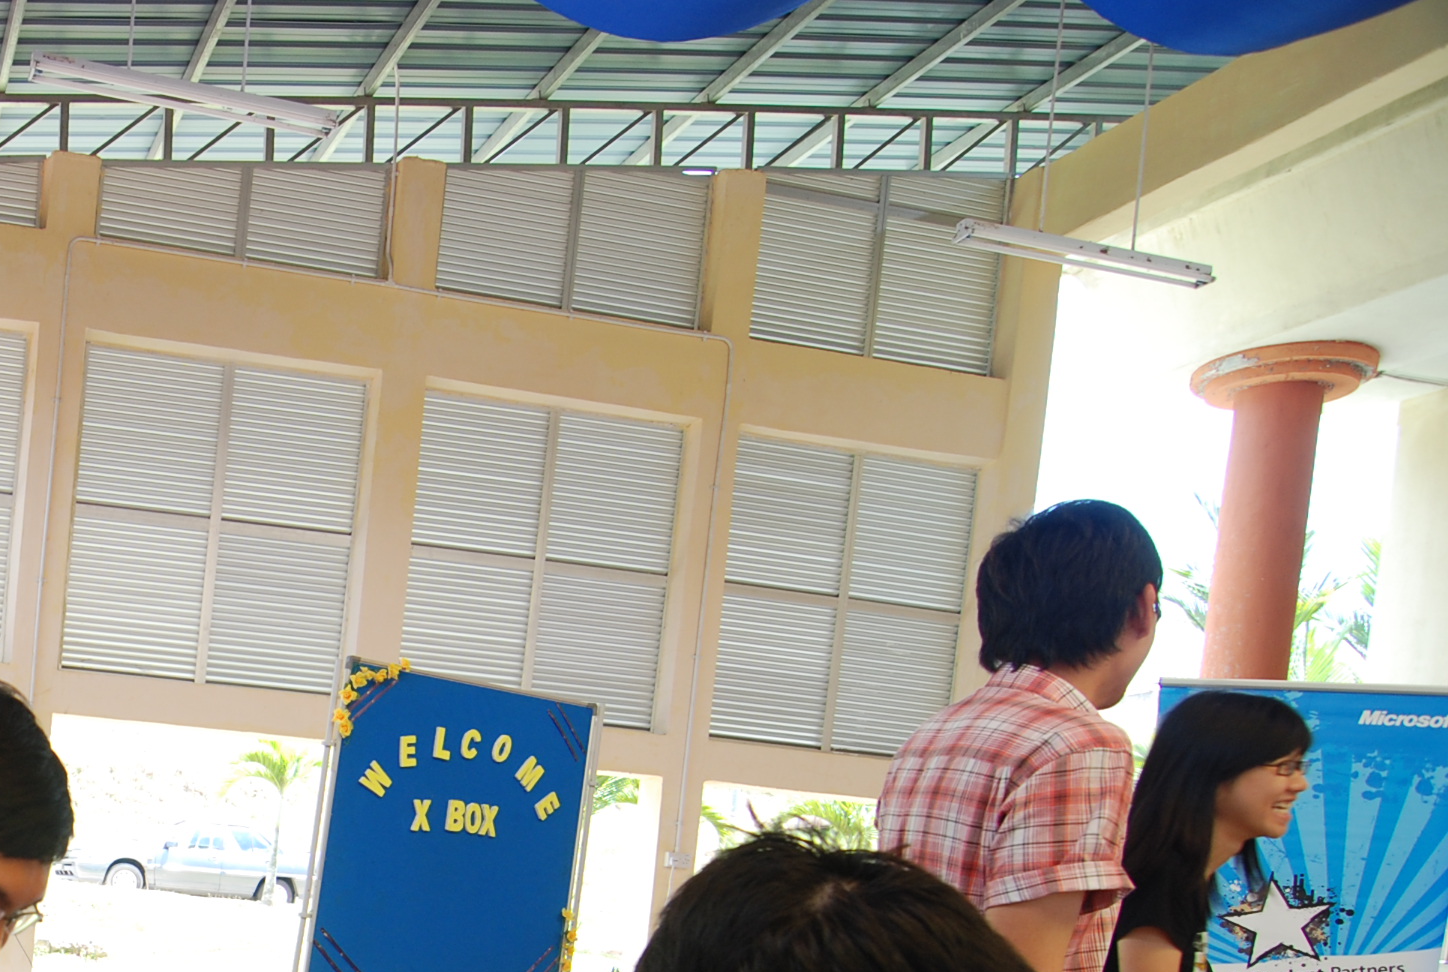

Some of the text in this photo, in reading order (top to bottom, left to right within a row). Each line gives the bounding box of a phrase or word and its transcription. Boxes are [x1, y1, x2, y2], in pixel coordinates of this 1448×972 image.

[358, 726, 561, 821] WELCOME
[410, 799, 499, 837] X BOX
